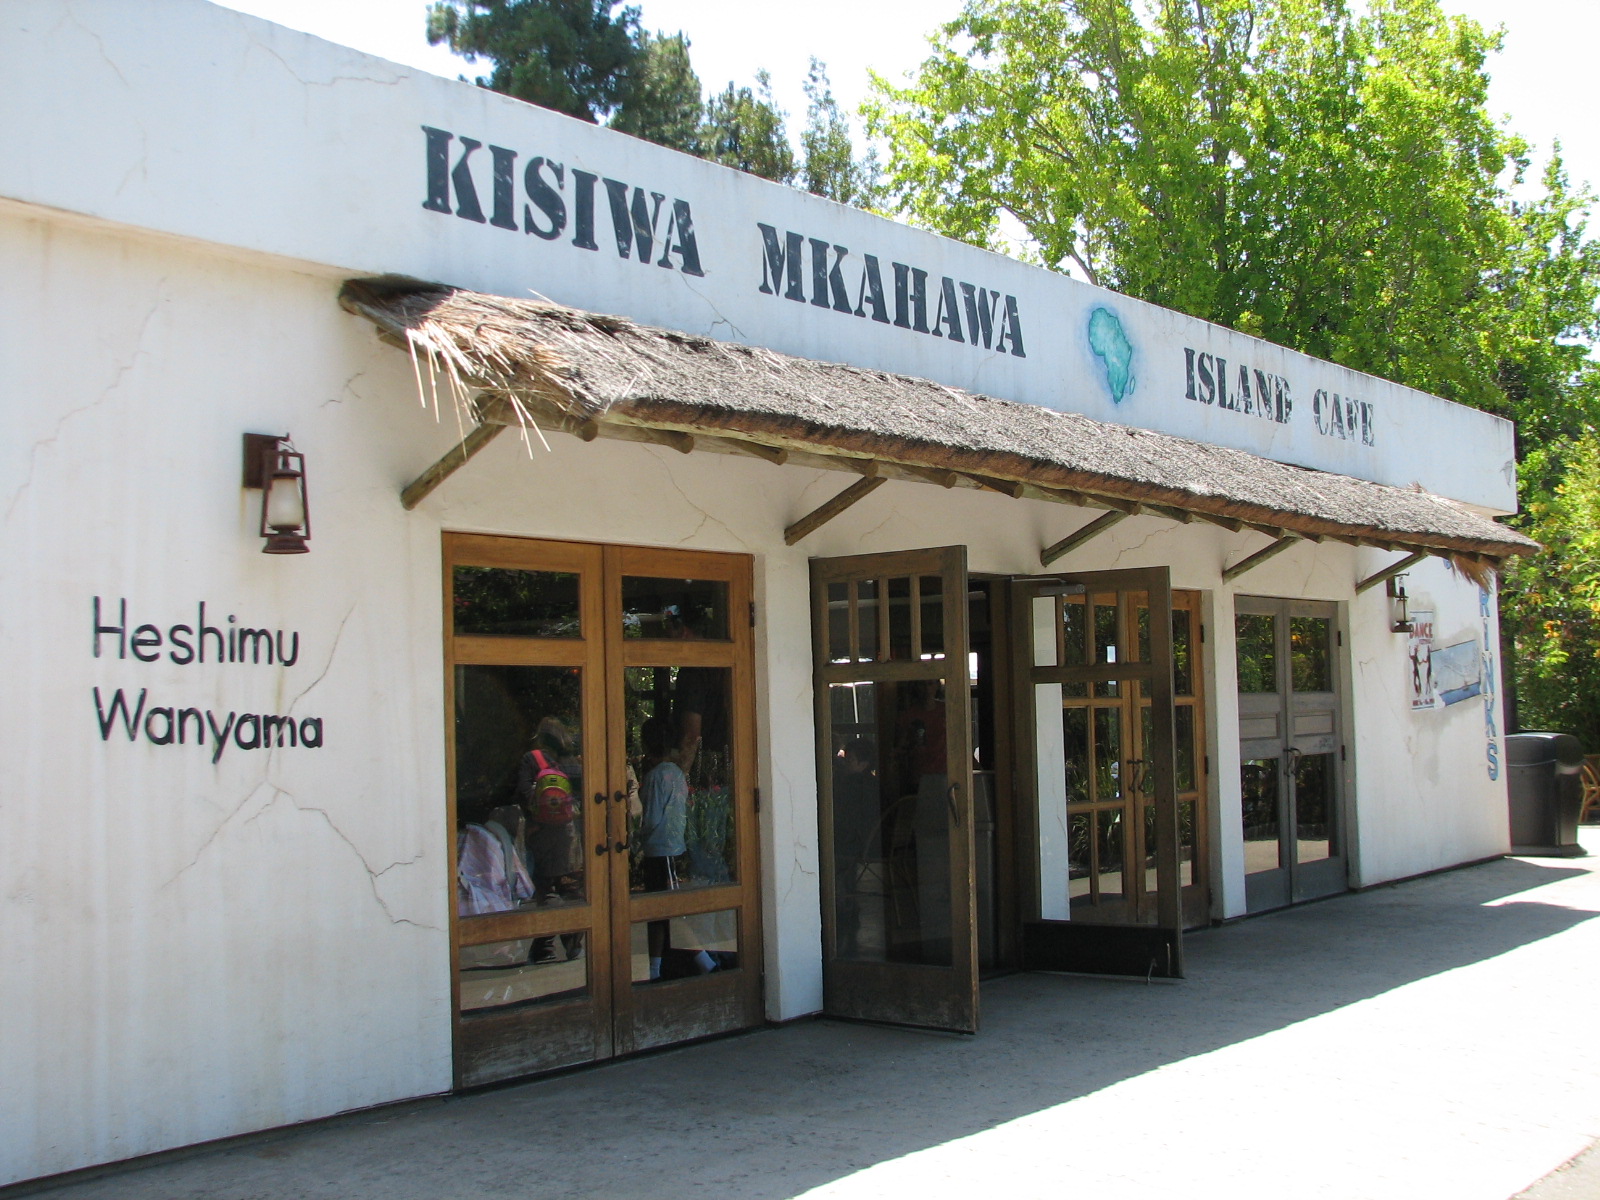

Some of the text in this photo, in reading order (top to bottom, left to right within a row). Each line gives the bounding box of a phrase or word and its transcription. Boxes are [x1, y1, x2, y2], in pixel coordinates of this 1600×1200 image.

[421, 125, 1026, 359] KISIWA MKAHAWA
[1184, 347, 1375, 447] ISLAND CAFE
[93, 595, 299, 667] Heshimu
[93, 686, 324, 765] Wanyama
